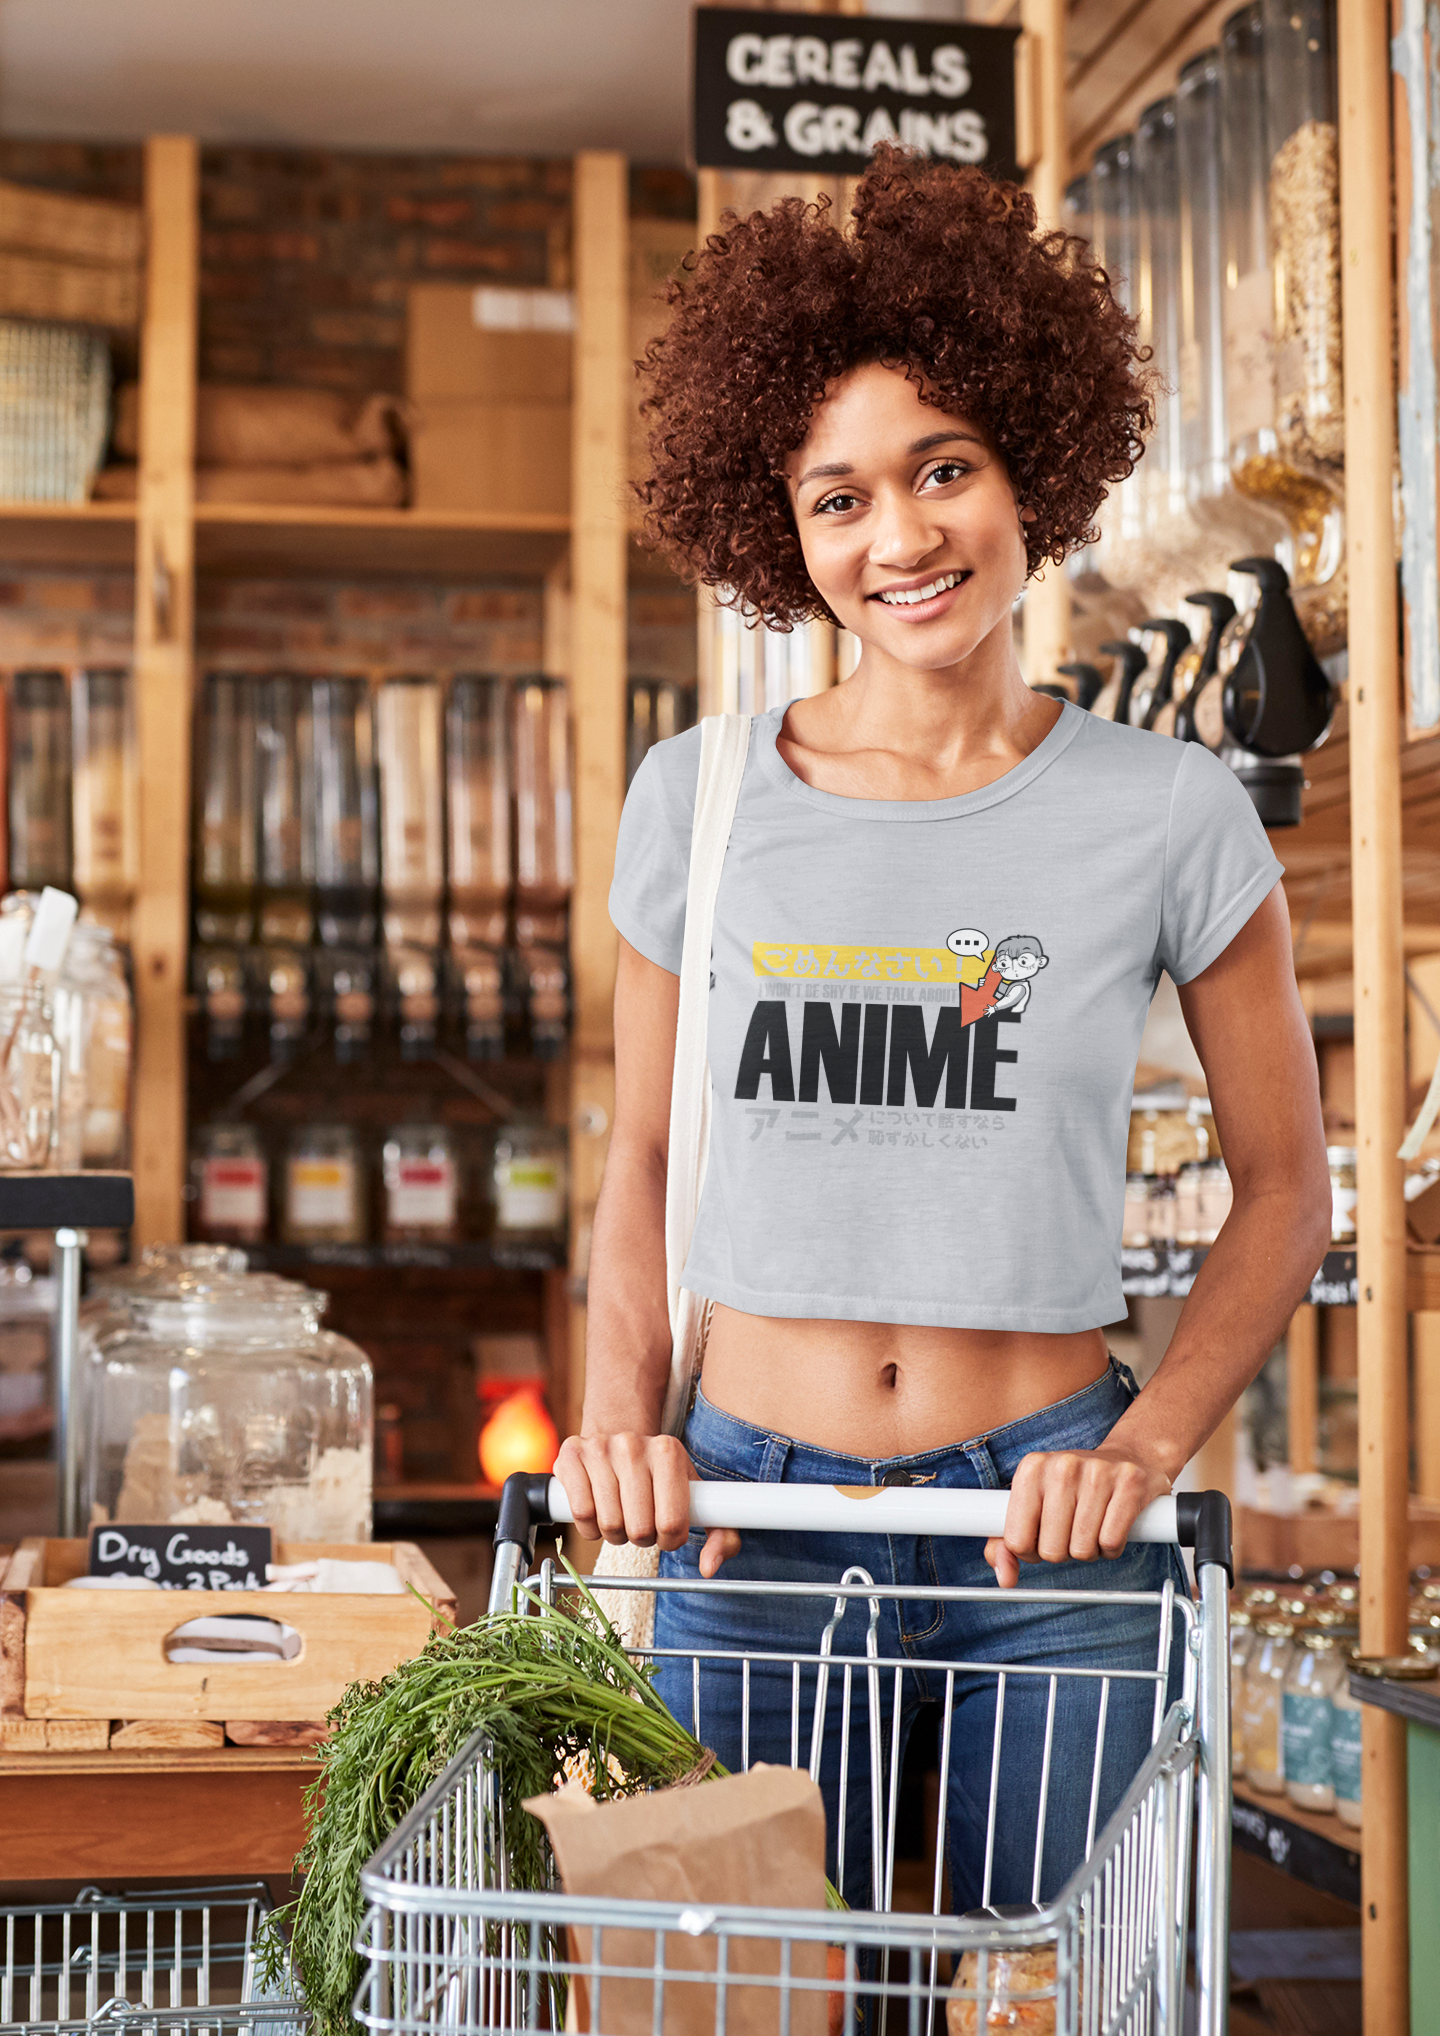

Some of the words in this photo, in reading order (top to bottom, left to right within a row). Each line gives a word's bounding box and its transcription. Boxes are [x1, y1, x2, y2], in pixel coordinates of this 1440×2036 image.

[726, 33, 971, 98] CEREALS
[726, 99, 778, 152] &
[784, 101, 988, 163] GRAINS
[805, 984, 820, 999] BE
[822, 984, 846, 1000] SHY
[849, 985, 860, 1000] IF
[862, 986, 882, 1001] WE
[885, 986, 915, 1002] TALK
[917, 988, 957, 1003] ABOUT
[734, 1000, 1021, 1112] ANIME
[745, 1107, 865, 1147] アニメ
[98, 1531, 161, 1579] Dry
[165, 1532, 250, 1568] Goods
